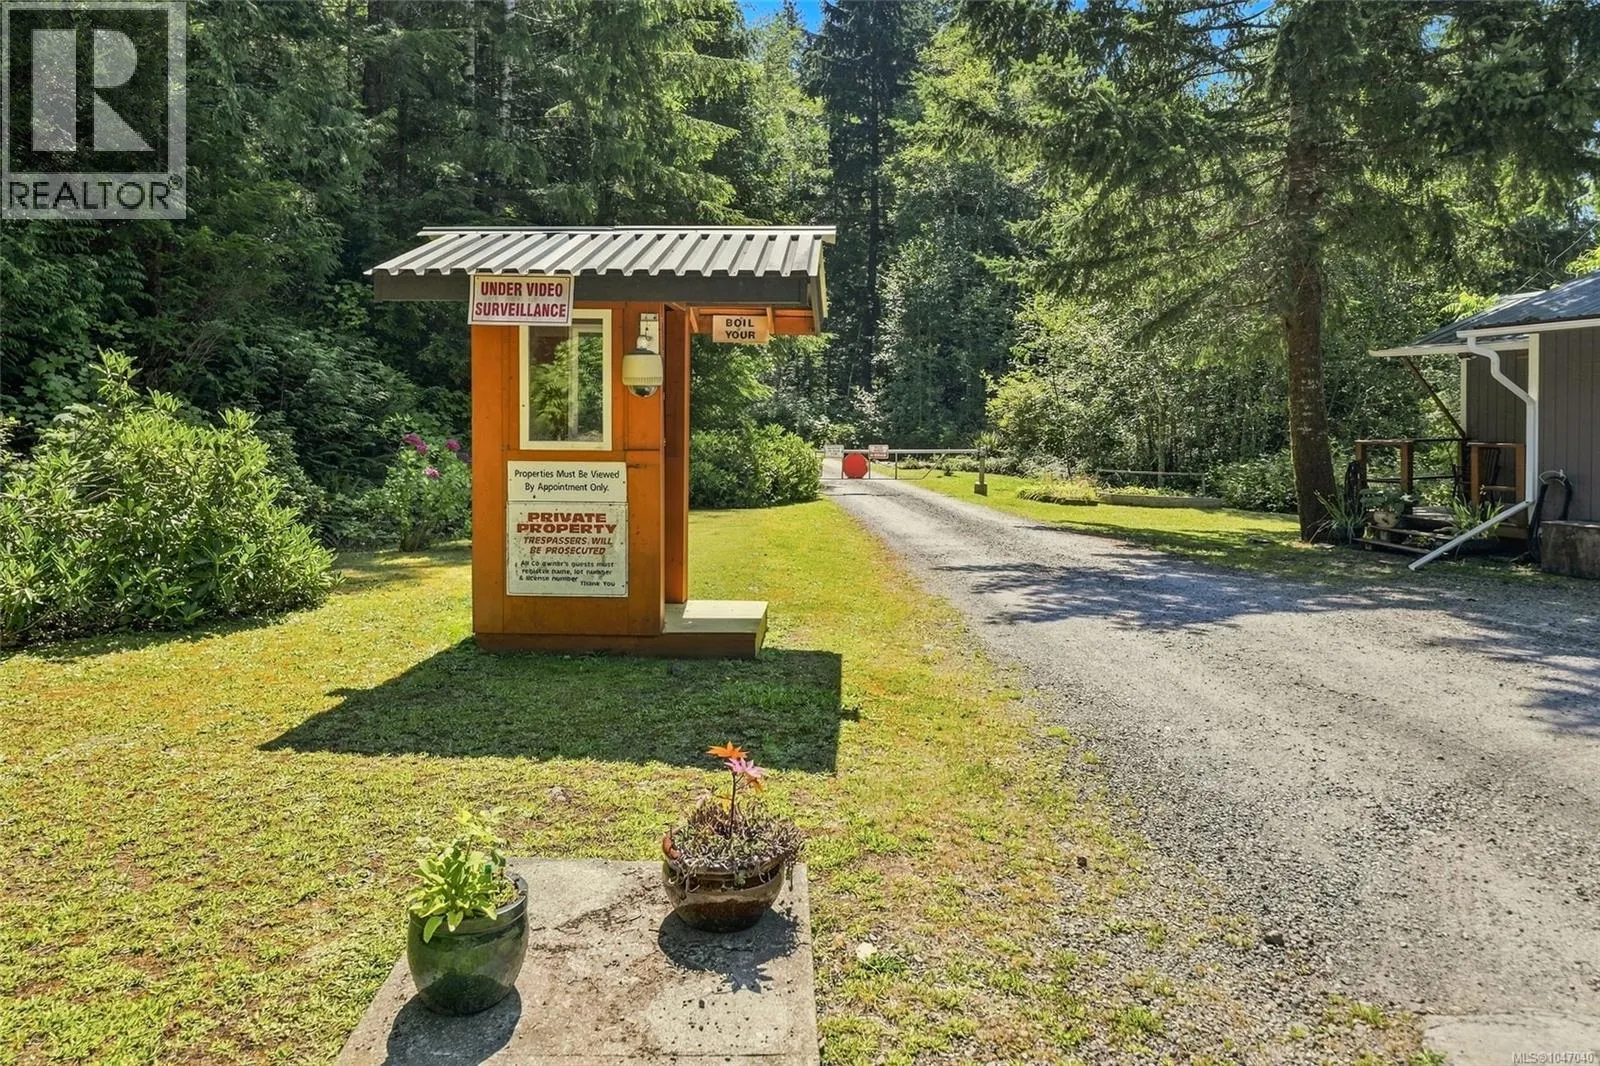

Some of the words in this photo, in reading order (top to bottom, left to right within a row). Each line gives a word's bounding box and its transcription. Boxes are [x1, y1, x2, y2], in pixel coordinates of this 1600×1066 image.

[481, 281, 522, 296] UNDER
[527, 283, 563, 297] VIDEO
[475, 302, 566, 317] SURVEILLANCE
[725, 318, 754, 328] BOIL
[725, 330, 755, 340] YOUR
[514, 469, 554, 479] Properties
[556, 470, 576, 479] Must
[578, 470, 588, 478] Be
[591, 470, 620, 479] Viewed
[525, 482, 535, 492] By
[538, 482, 588, 492] Appointment
[590, 483, 610, 493] Only.
[527, 512, 607, 523] PRIVATE
[516, 523, 617, 534] PROPERTY
[524, 536, 587, 545] TRESPASSERS
[591, 537, 613, 545] WILL
[529, 546, 542, 555] BE
[545, 547, 606, 555] PROSECUTED
